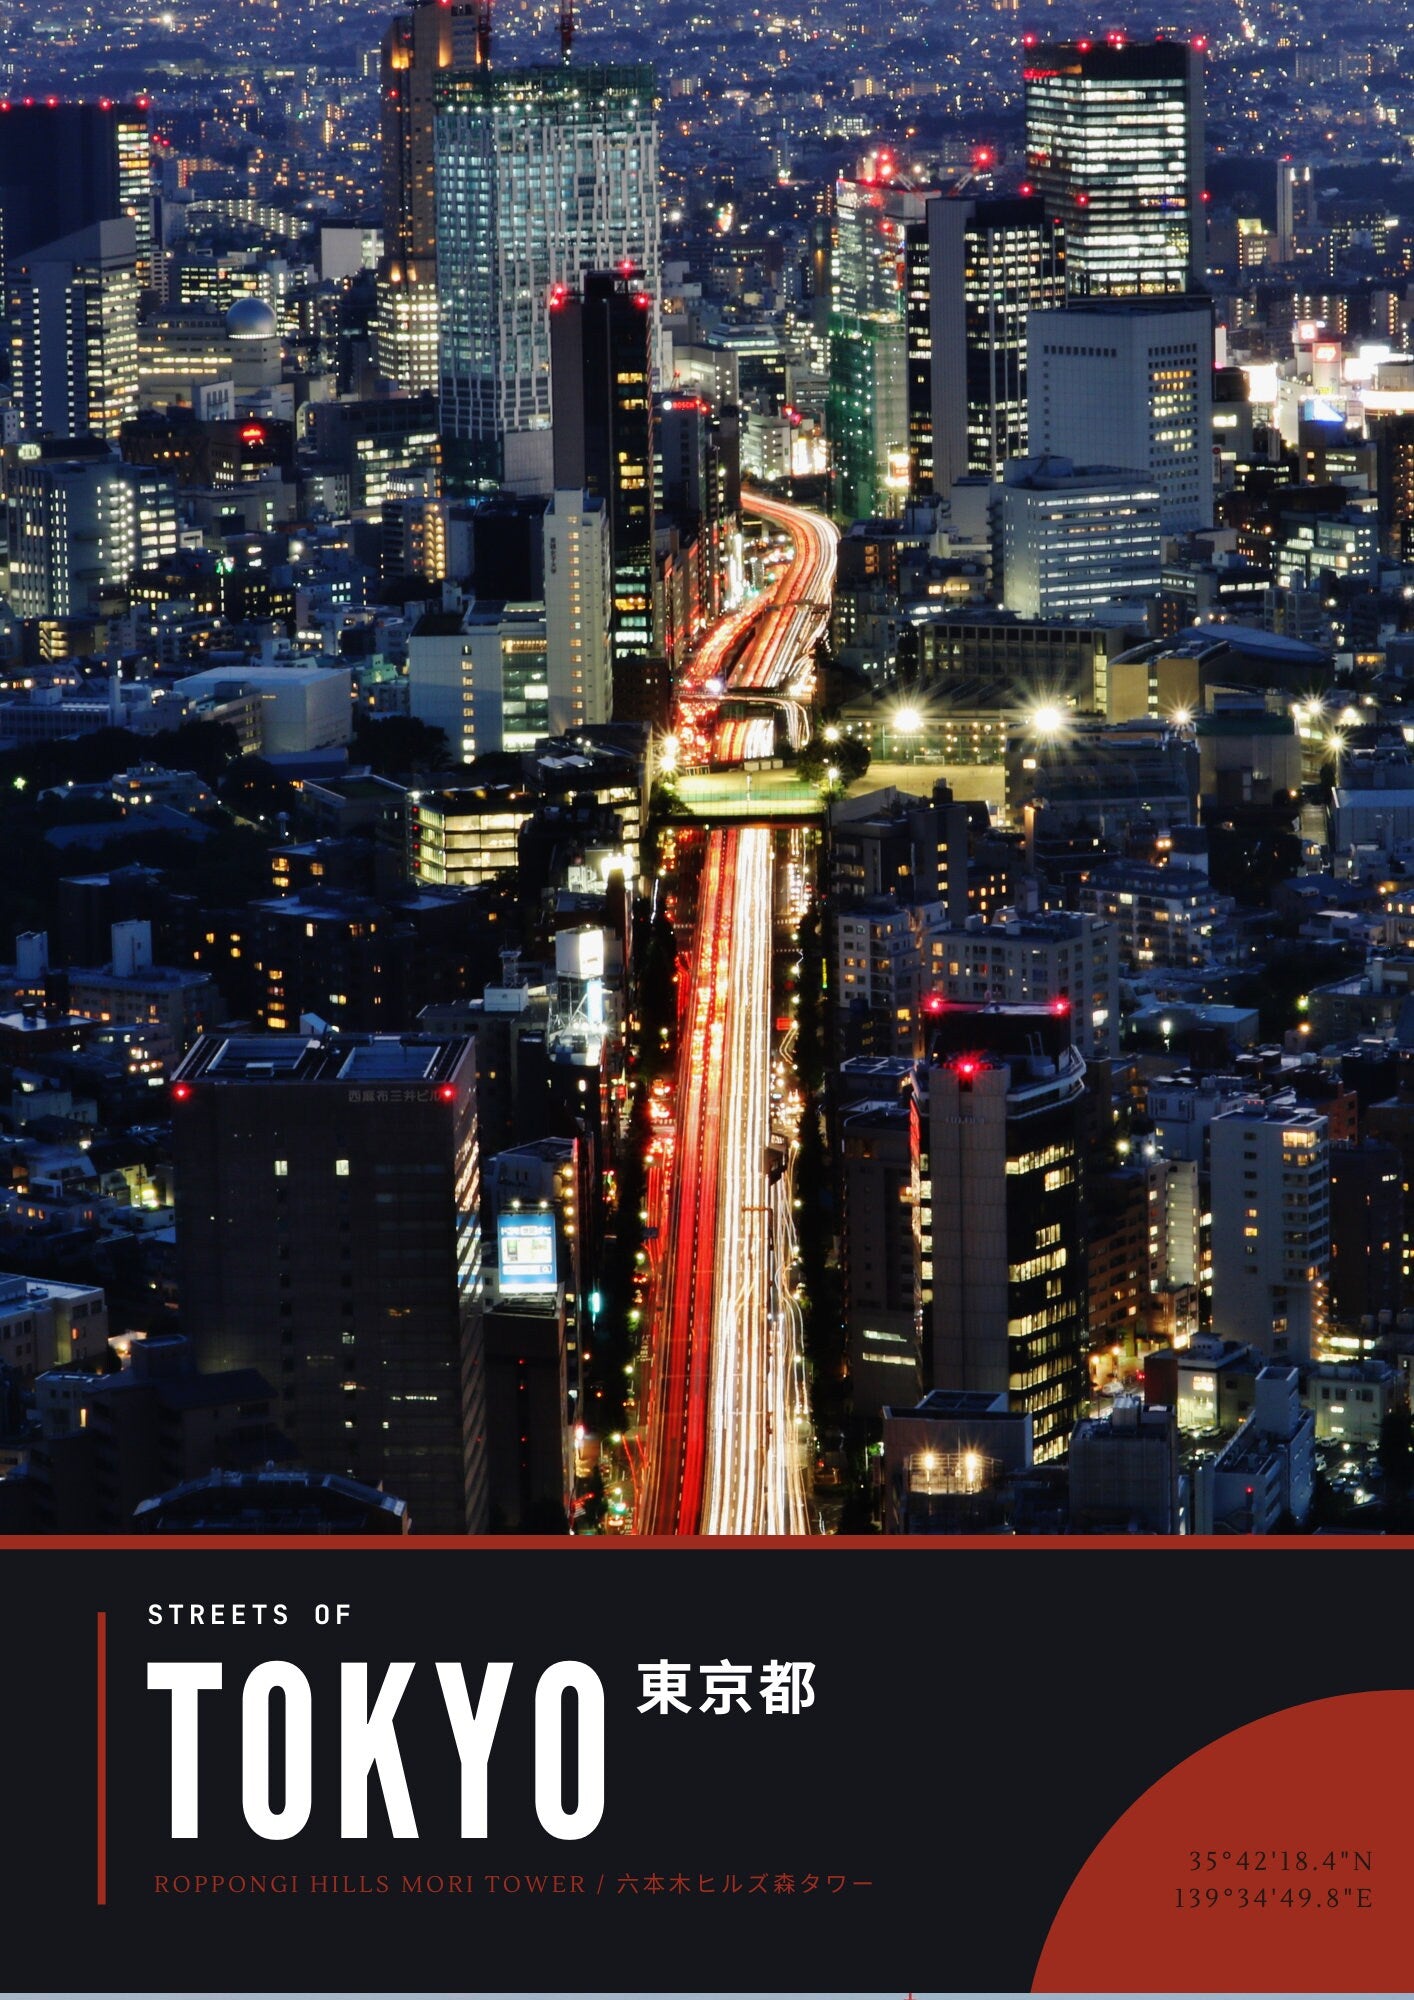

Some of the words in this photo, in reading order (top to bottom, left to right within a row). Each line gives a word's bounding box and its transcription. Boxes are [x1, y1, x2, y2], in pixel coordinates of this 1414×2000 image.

[672, 401, 695, 409] BOSCH
[348, 1090, 440, 1102] 西麻布三井ビル
